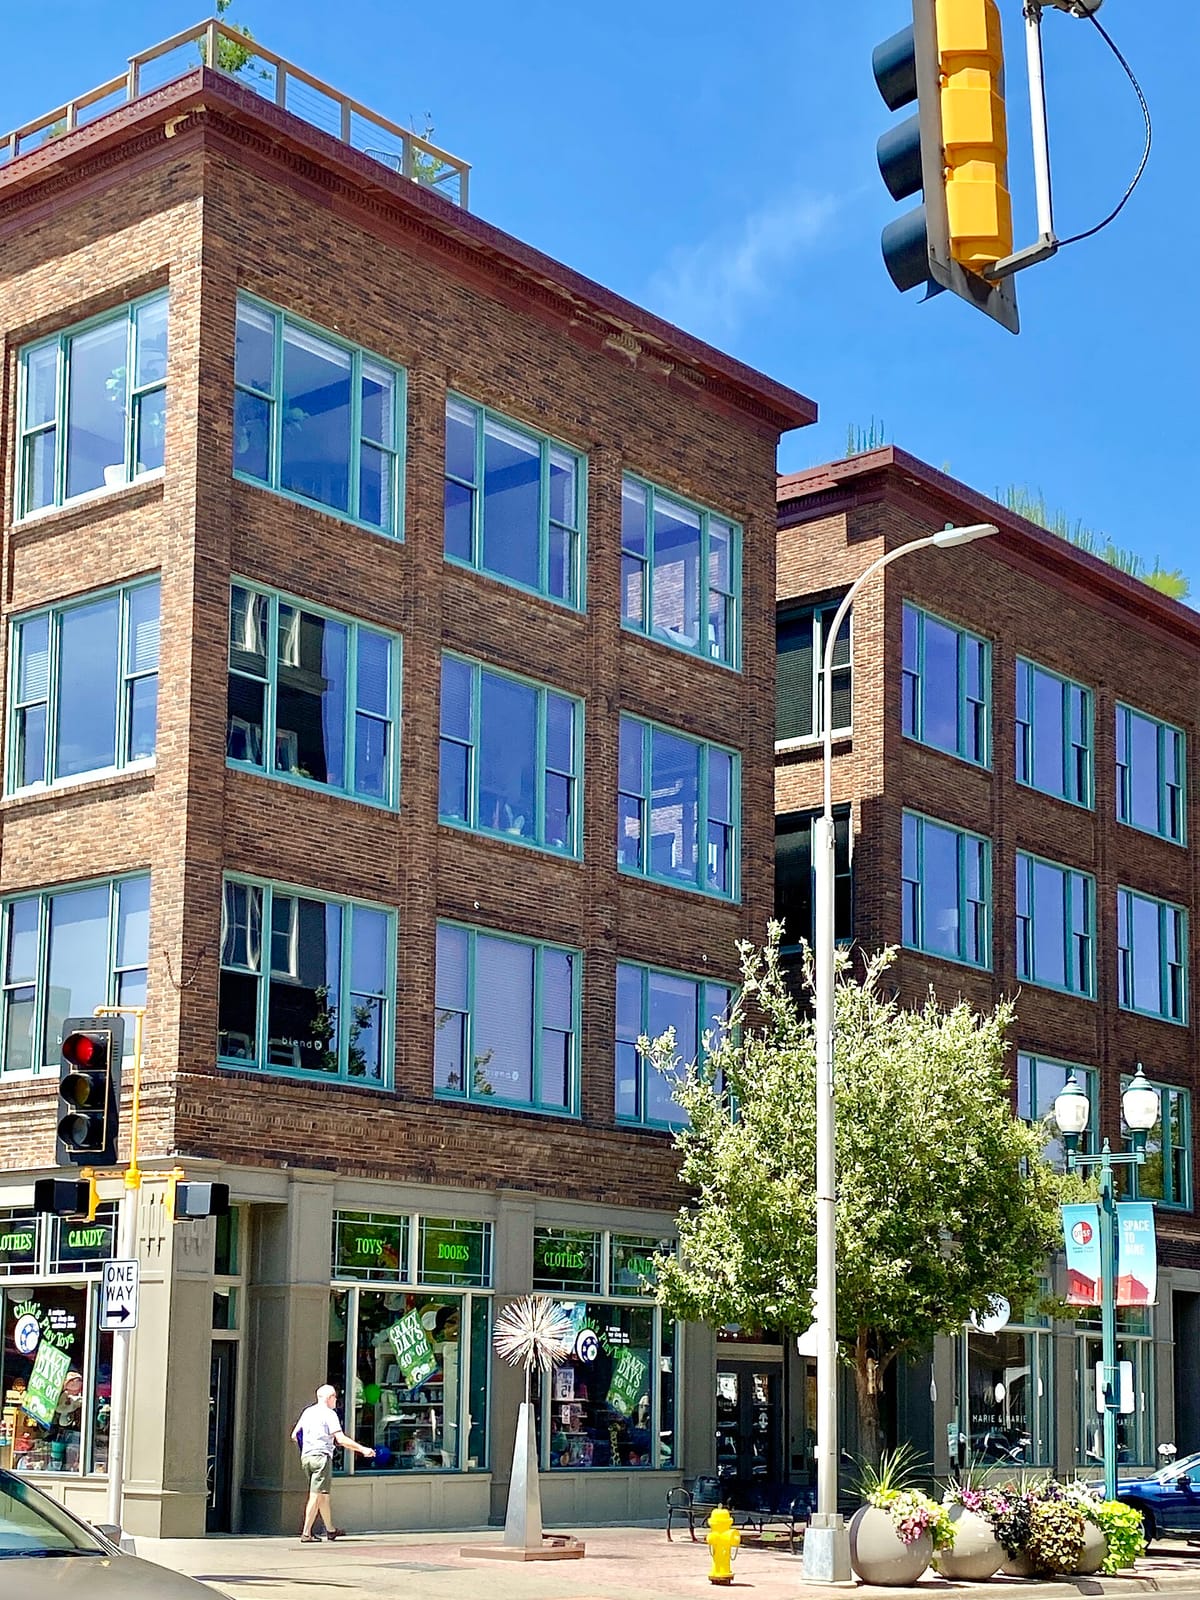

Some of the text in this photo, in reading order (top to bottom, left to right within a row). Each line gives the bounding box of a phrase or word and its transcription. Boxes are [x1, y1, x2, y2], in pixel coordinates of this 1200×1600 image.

[281, 1036, 312, 1049] blend
[1122, 1220, 1150, 1232] SPACE
[68, 1228, 106, 1248] CANDY
[355, 1238, 383, 1256] TOYS
[1124, 1232, 1136, 1244] TO
[438, 1243, 470, 1261] BOOKS
[544, 1251, 585, 1270] CLOTHES
[107, 1266, 134, 1282] ONE
[627, 1257, 651, 1275] CAND
[106, 1285, 134, 1301] WAY
[13, 1301, 42, 1320] Child's
[39, 1315, 57, 1344] Play
[56, 1332, 75, 1349] Toys
[389, 1312, 418, 1342] CRAZY
[394, 1324, 424, 1356] DAYS
[39, 1344, 69, 1374] CRAZY
[36, 1358, 63, 1388] DAYS
[617, 1360, 640, 1388] DAYS
[972, 1414, 1028, 1424] MARIE & MARIE
